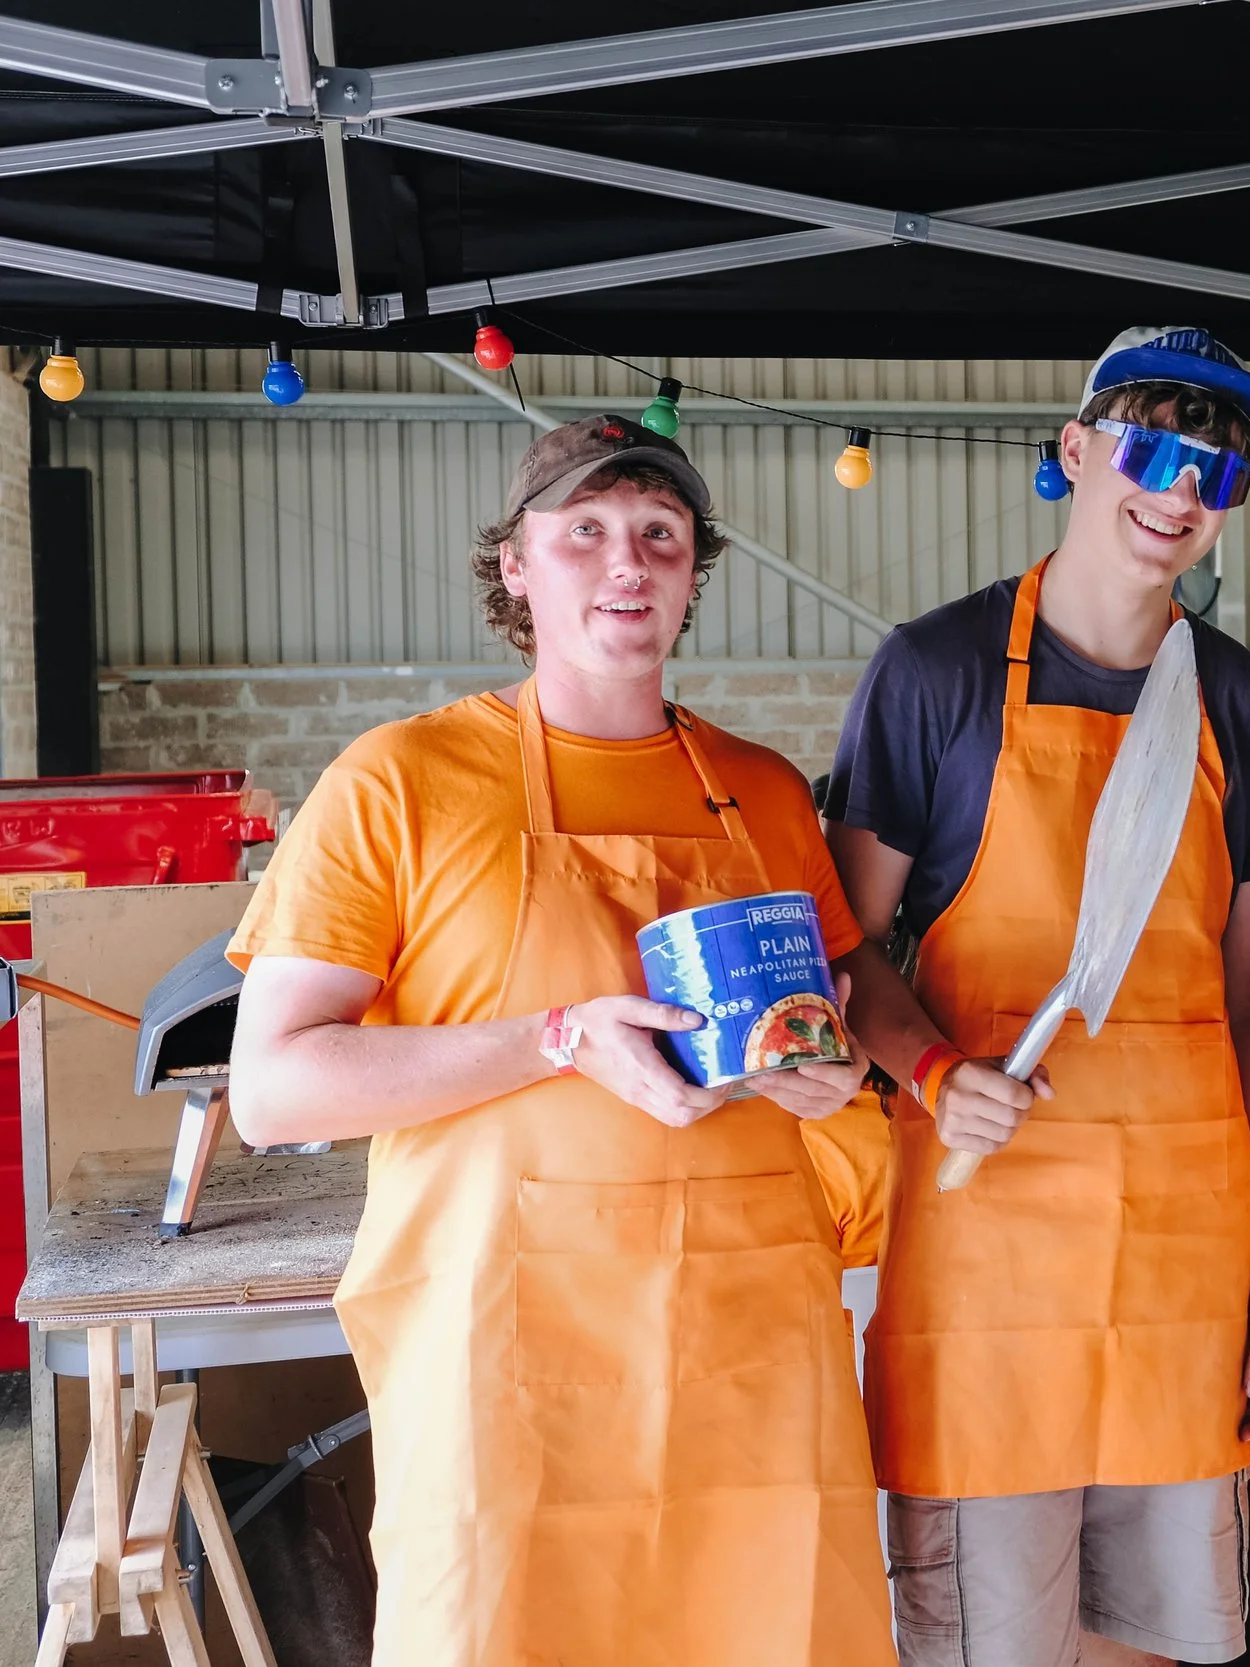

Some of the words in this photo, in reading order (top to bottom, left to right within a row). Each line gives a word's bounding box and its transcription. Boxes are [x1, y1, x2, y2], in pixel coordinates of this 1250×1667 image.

[751, 906, 804, 925] REGGIA
[760, 935, 811, 957] PLAIN
[730, 957, 806, 979] NEAPOLITAN
[775, 970, 811, 983] SAUCE
